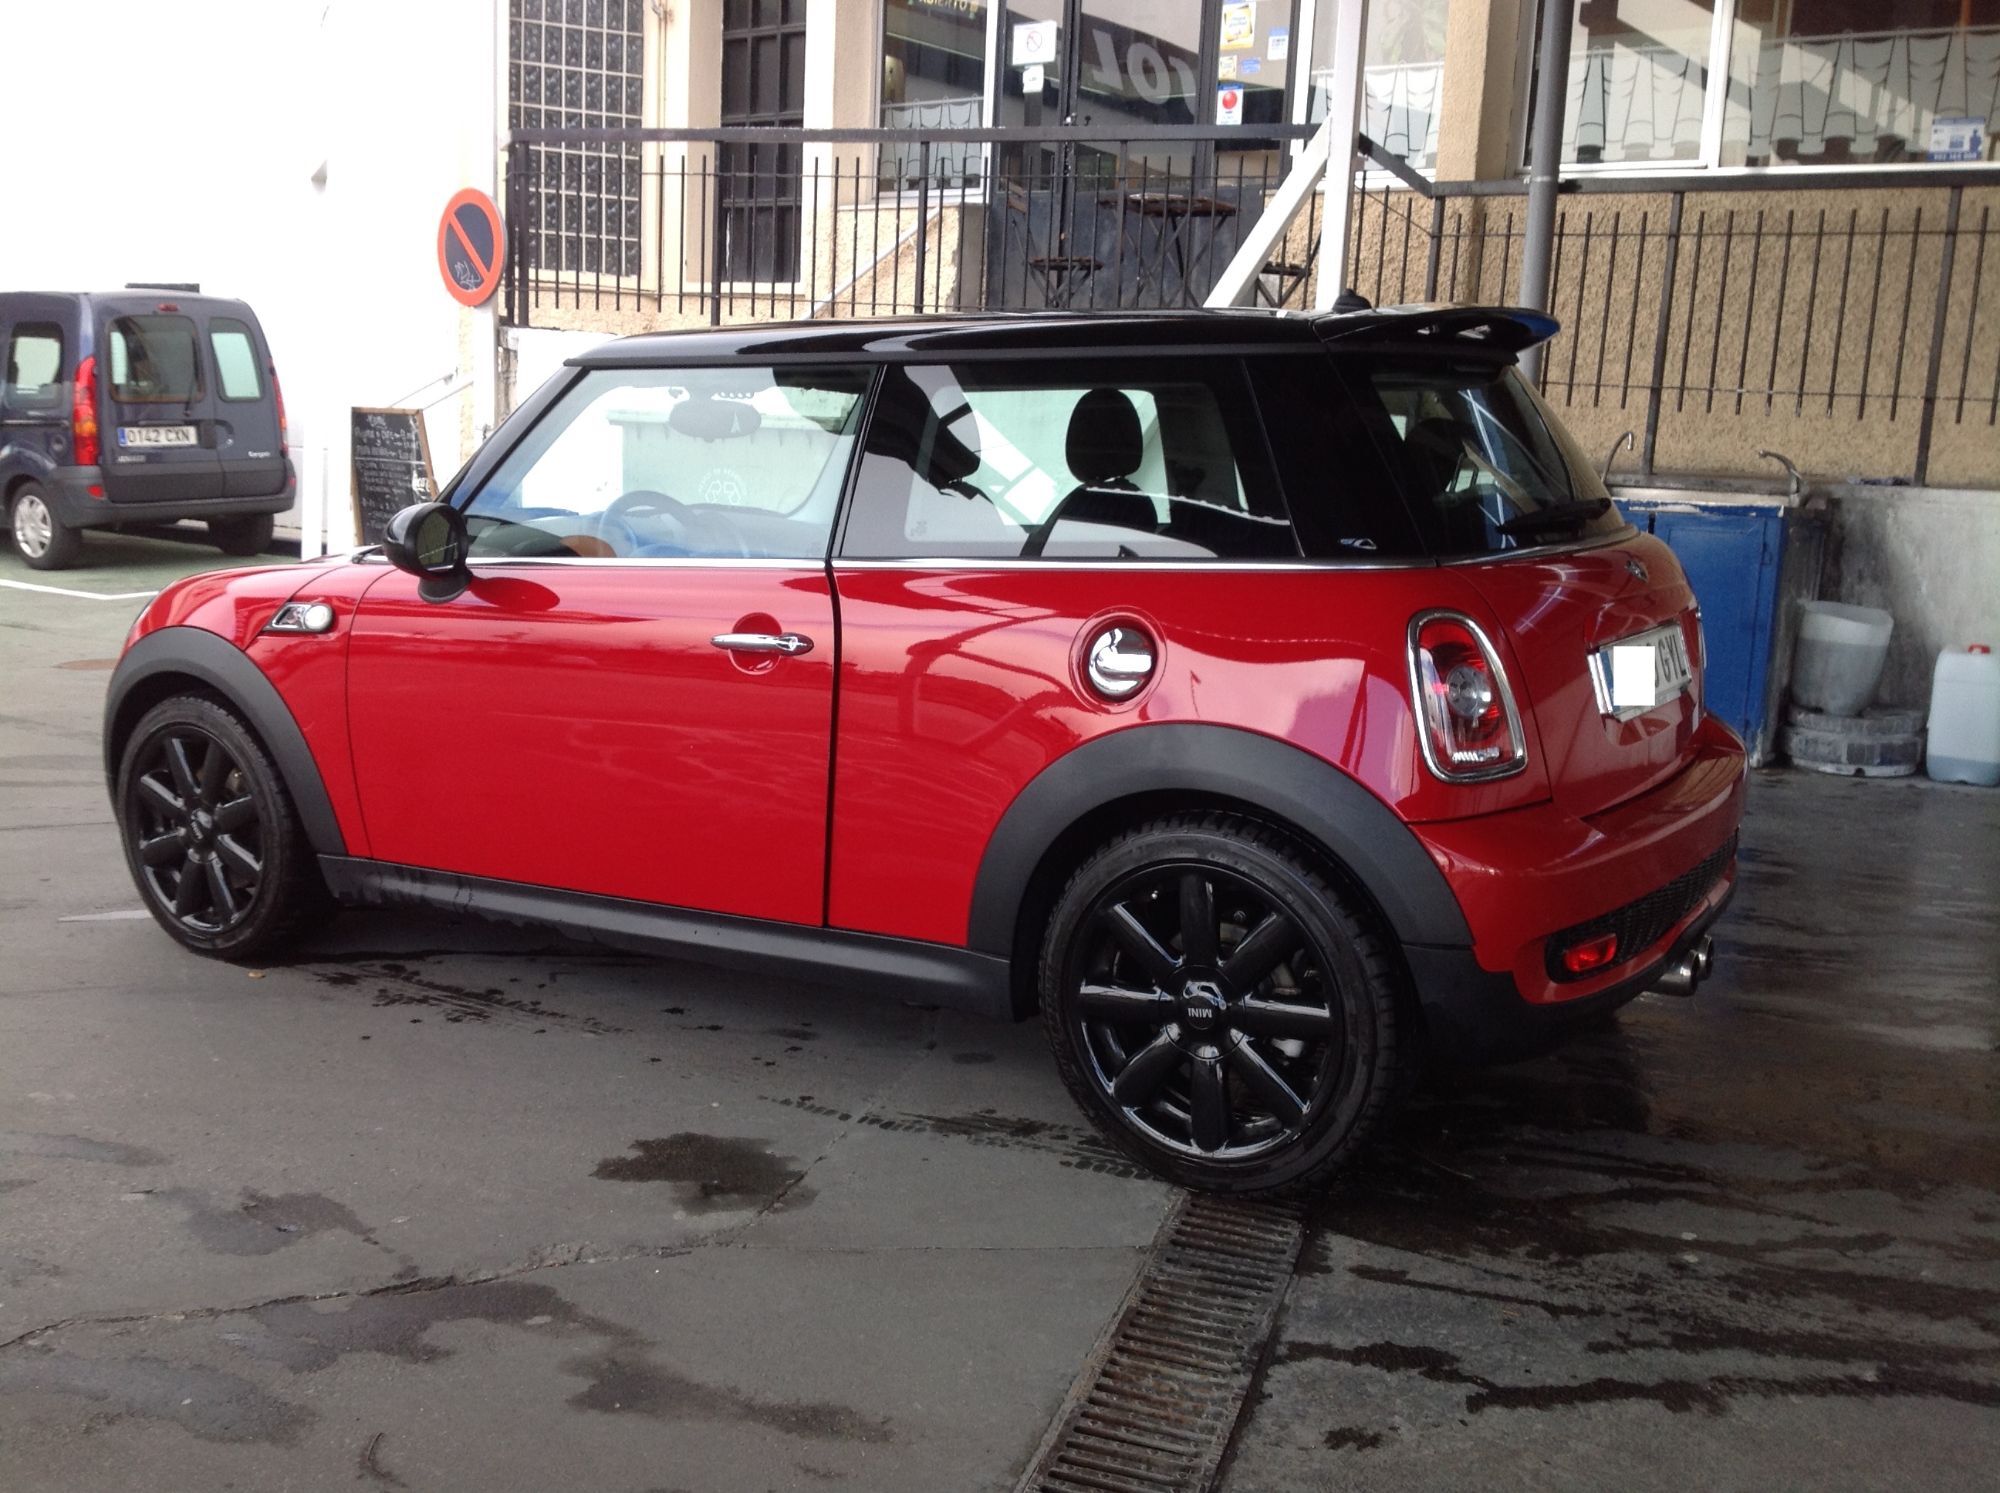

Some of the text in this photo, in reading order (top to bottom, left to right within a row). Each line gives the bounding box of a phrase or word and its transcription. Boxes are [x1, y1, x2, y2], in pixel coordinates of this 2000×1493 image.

[127, 428, 191, 443] 0142 CXN
[1658, 634, 1687, 682] GYL
[1187, 1007, 1213, 1018] MINI
